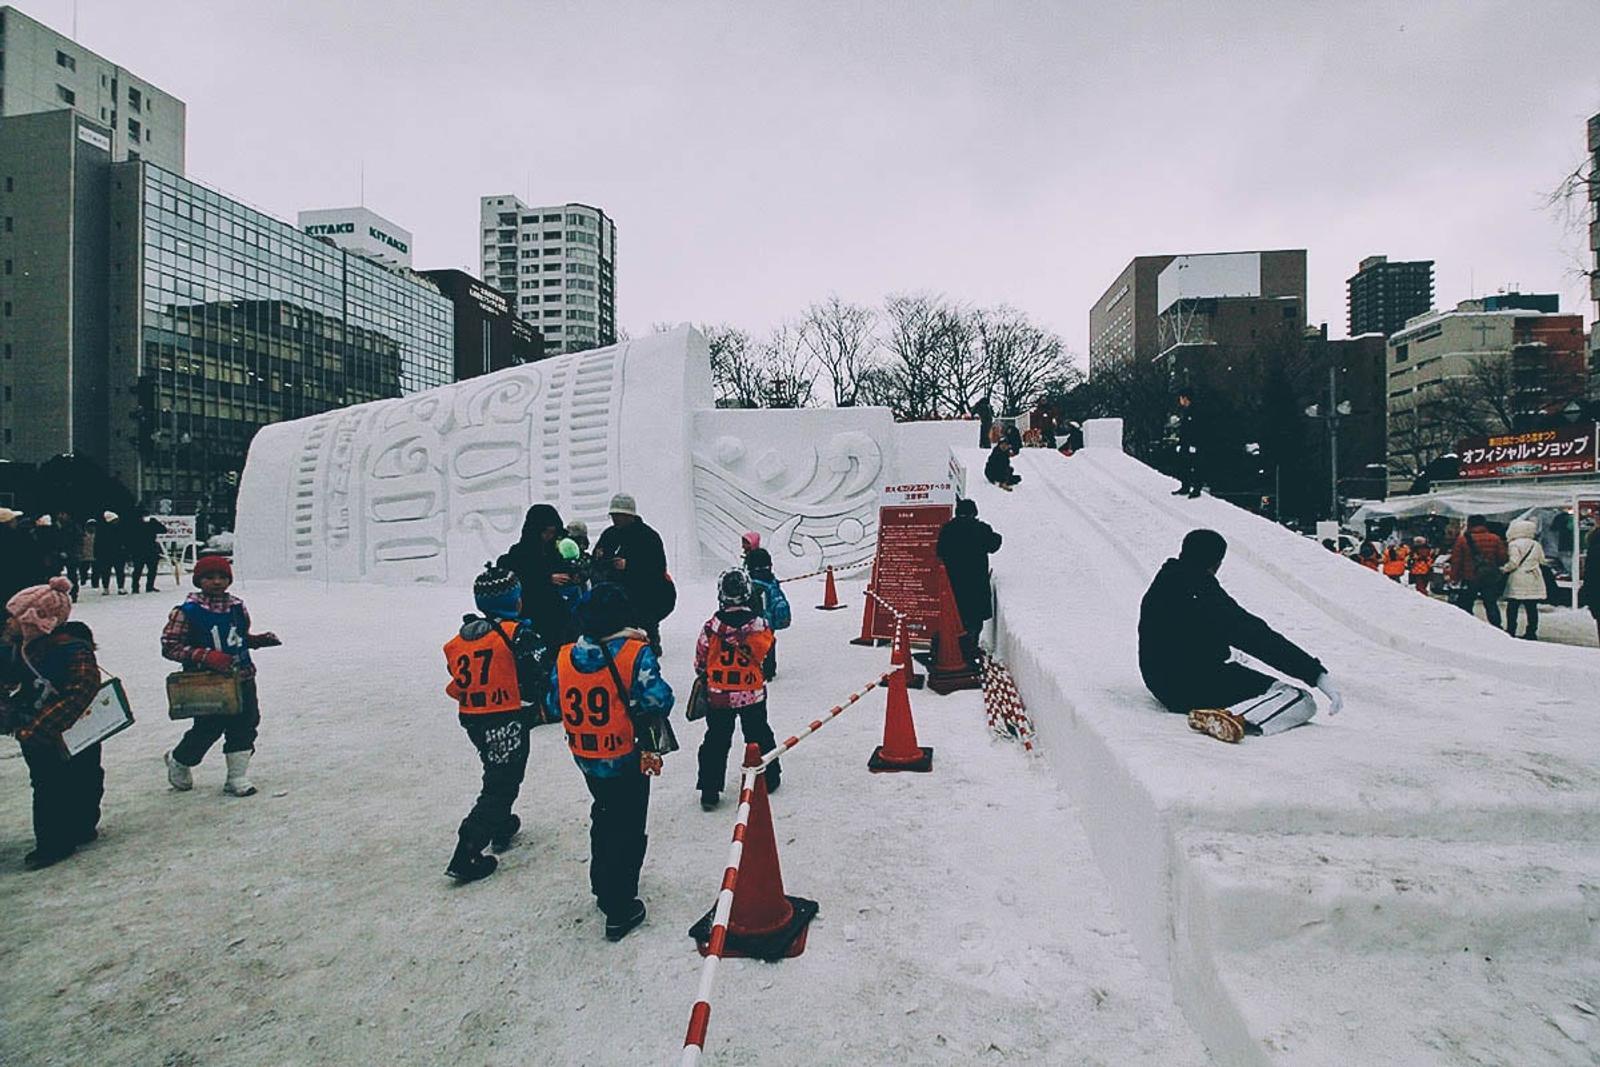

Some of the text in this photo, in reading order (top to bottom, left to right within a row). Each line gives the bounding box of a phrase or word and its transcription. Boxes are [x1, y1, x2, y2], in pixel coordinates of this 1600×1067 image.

[305, 223, 354, 235] KITAKO
[369, 226, 408, 254] KITAKO
[1462, 435, 1589, 464] オフィシャル・ショップ
[210, 625, 243, 651] 14
[455, 648, 494, 689] 37
[565, 686, 610, 727] 39
